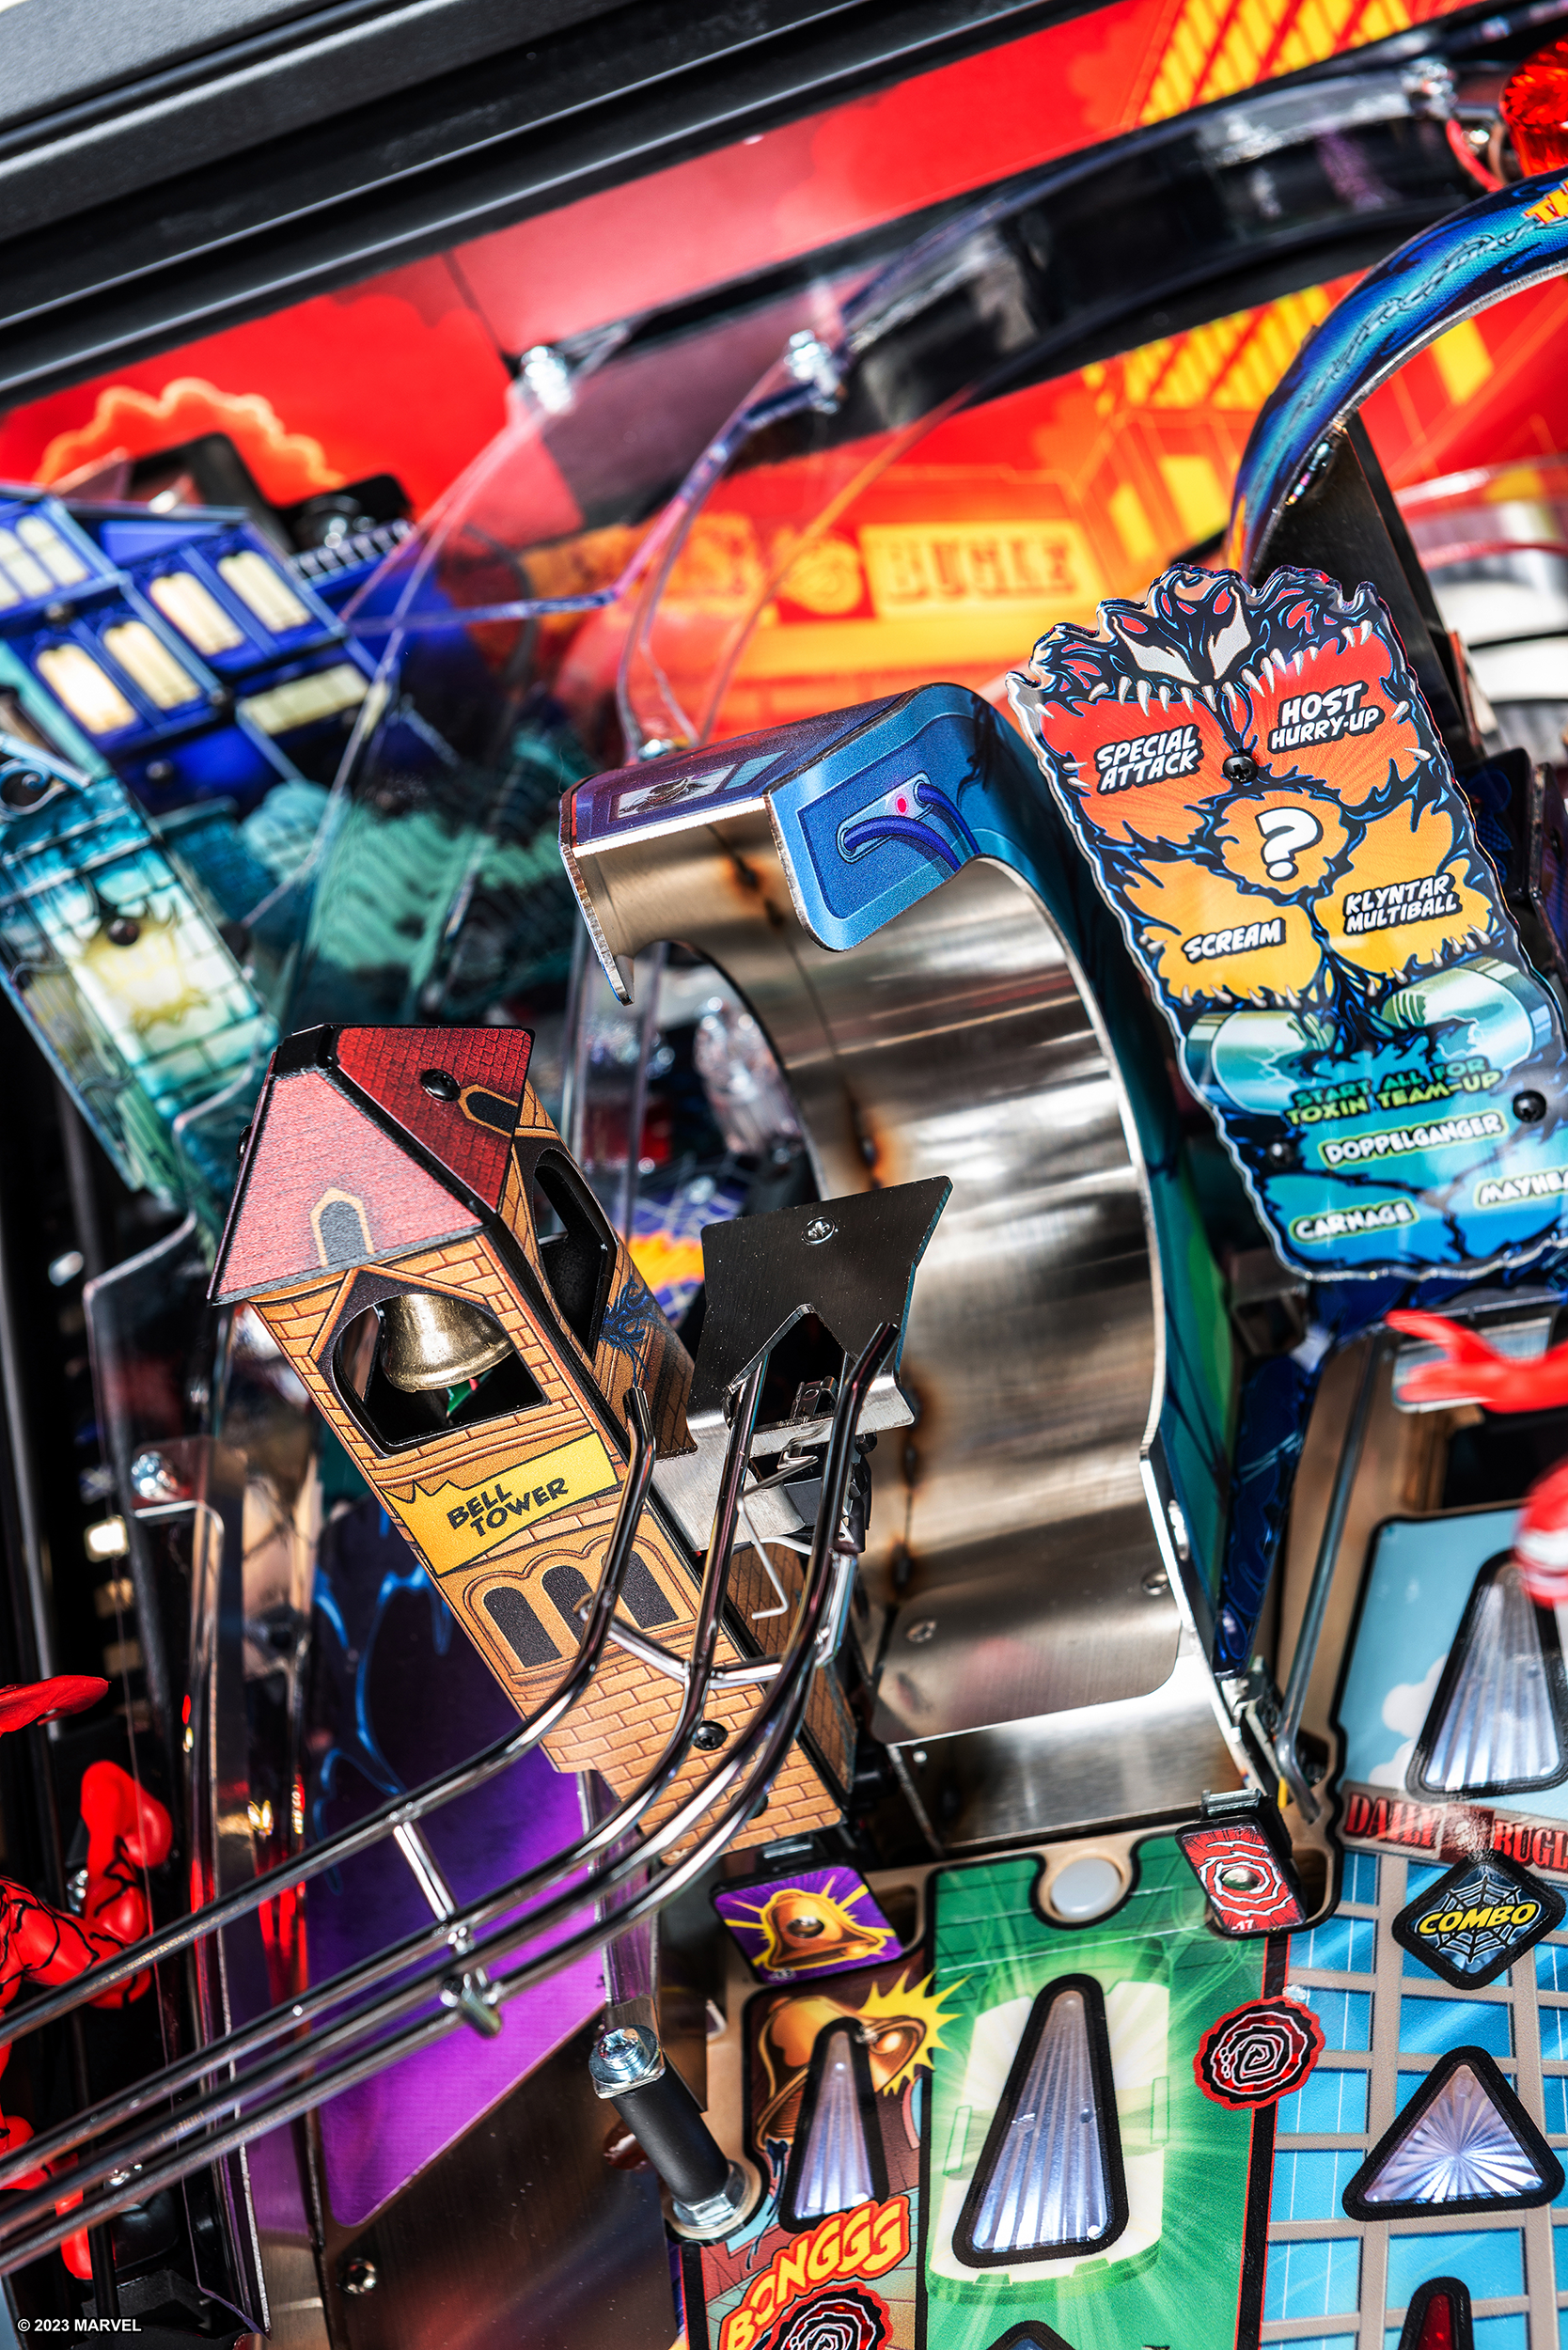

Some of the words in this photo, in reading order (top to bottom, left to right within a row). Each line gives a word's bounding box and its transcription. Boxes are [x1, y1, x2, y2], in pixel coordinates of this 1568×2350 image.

[1281, 682, 1363, 727] HOST
[1097, 726, 1197, 770] SPECIAL
[1271, 708, 1380, 750] HURRY-UP
[1100, 748, 1199, 791] ATTACK
[1257, 807, 1319, 879] ?
[1345, 874, 1450, 916] KLYNTAR
[1346, 893, 1457, 932] MULTIBALL
[1184, 918, 1281, 961] SCREAM
[1286, 1095, 1370, 1125] TOXIN
[1376, 1070, 1501, 1108] TEAM-UP
[1294, 1081, 1371, 1107] START
[1383, 1070, 1424, 1091] ALL
[1432, 1057, 1488, 1080] FOR
[1324, 1113, 1503, 1165] DOPPELGANGER
[1294, 1202, 1413, 1240] CARNAGE
[447, 1483, 512, 1530] BELL
[470, 1478, 569, 1537] TOWER
[1344, 1792, 1442, 1849] DAILY
[1419, 1904, 1537, 1935] COMBO
[726, 2202, 902, 2350] BONGGG
